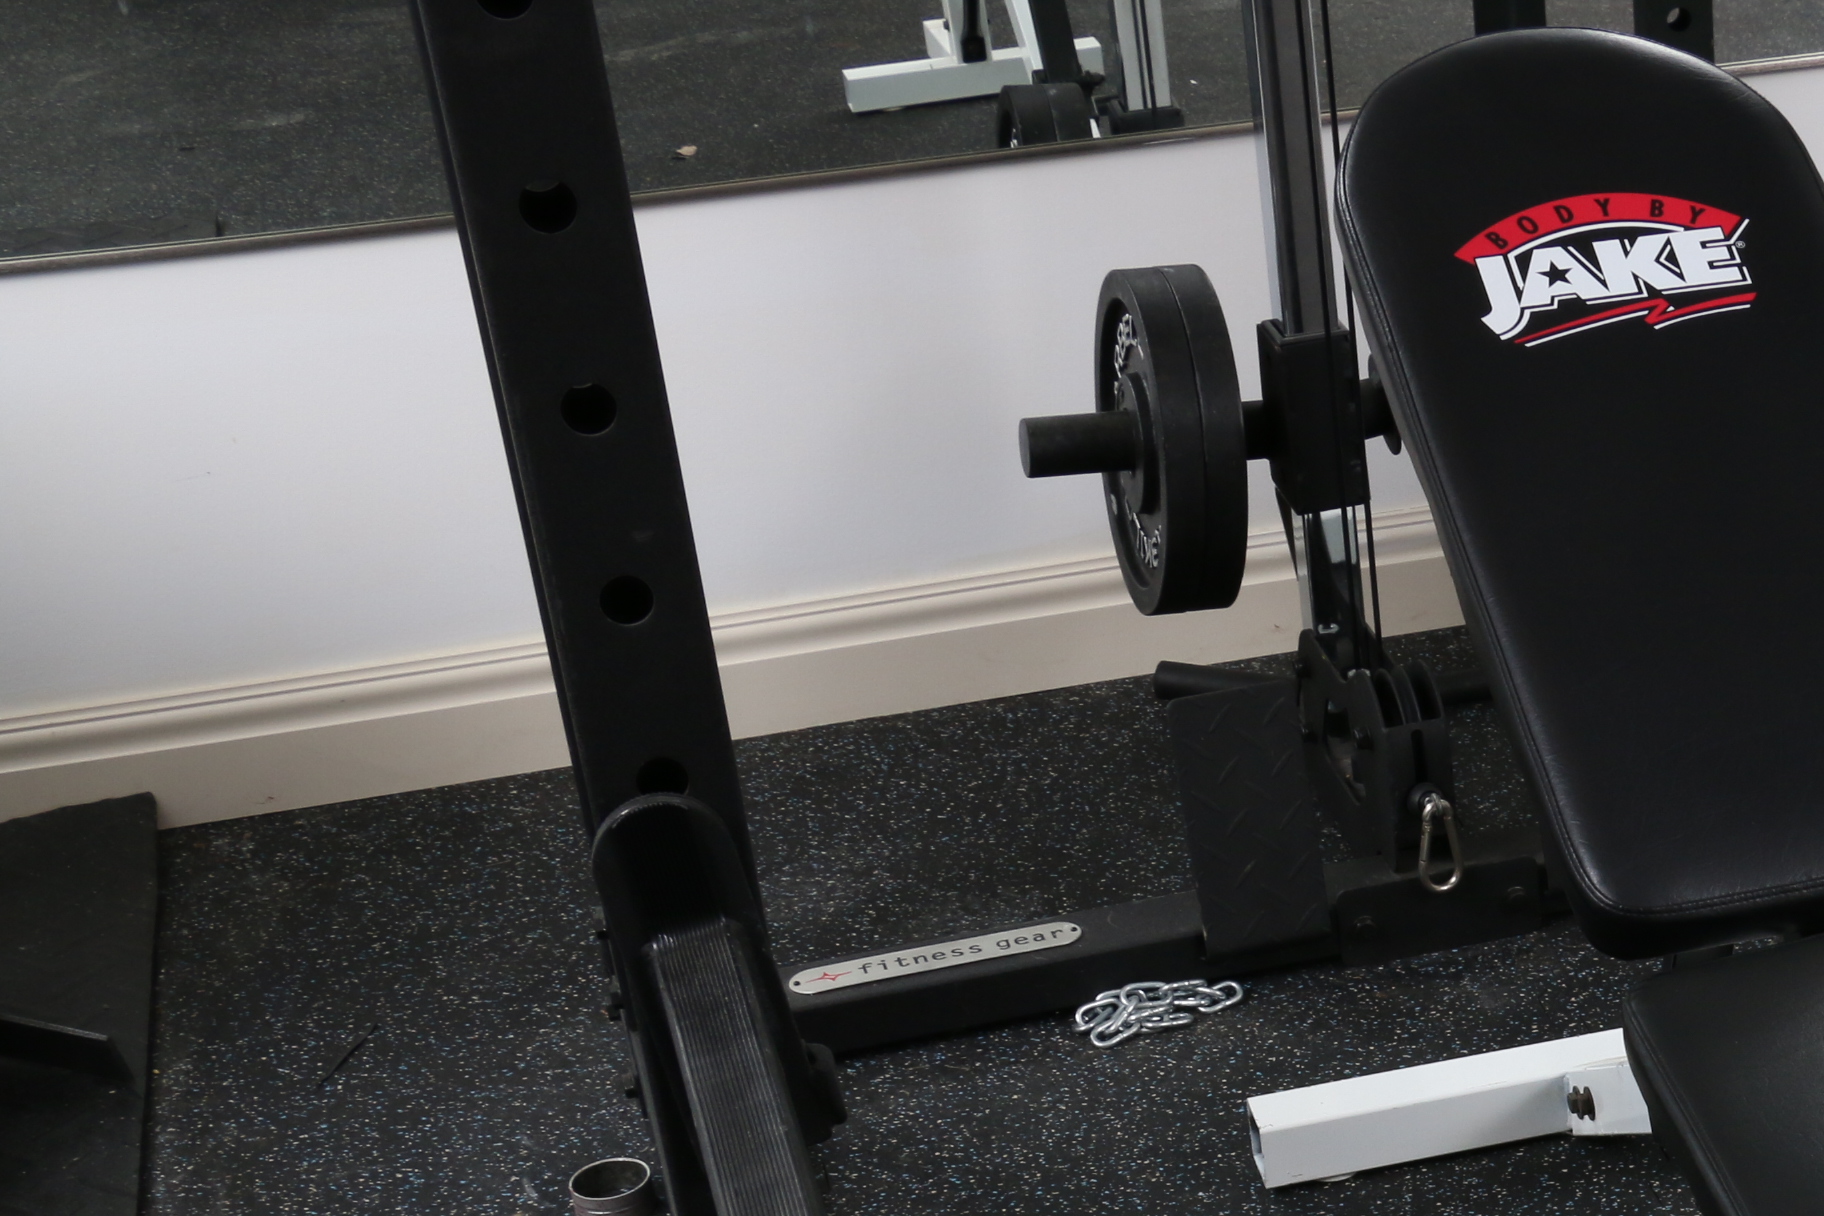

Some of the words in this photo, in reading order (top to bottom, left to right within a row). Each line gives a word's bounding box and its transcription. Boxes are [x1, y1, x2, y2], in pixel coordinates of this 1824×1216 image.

[1484, 197, 1612, 251] BODY
[1649, 199, 1706, 226] BY
[1474, 222, 1748, 338] JAKE
[858, 942, 984, 975] fitness
[996, 927, 1064, 951] gear
